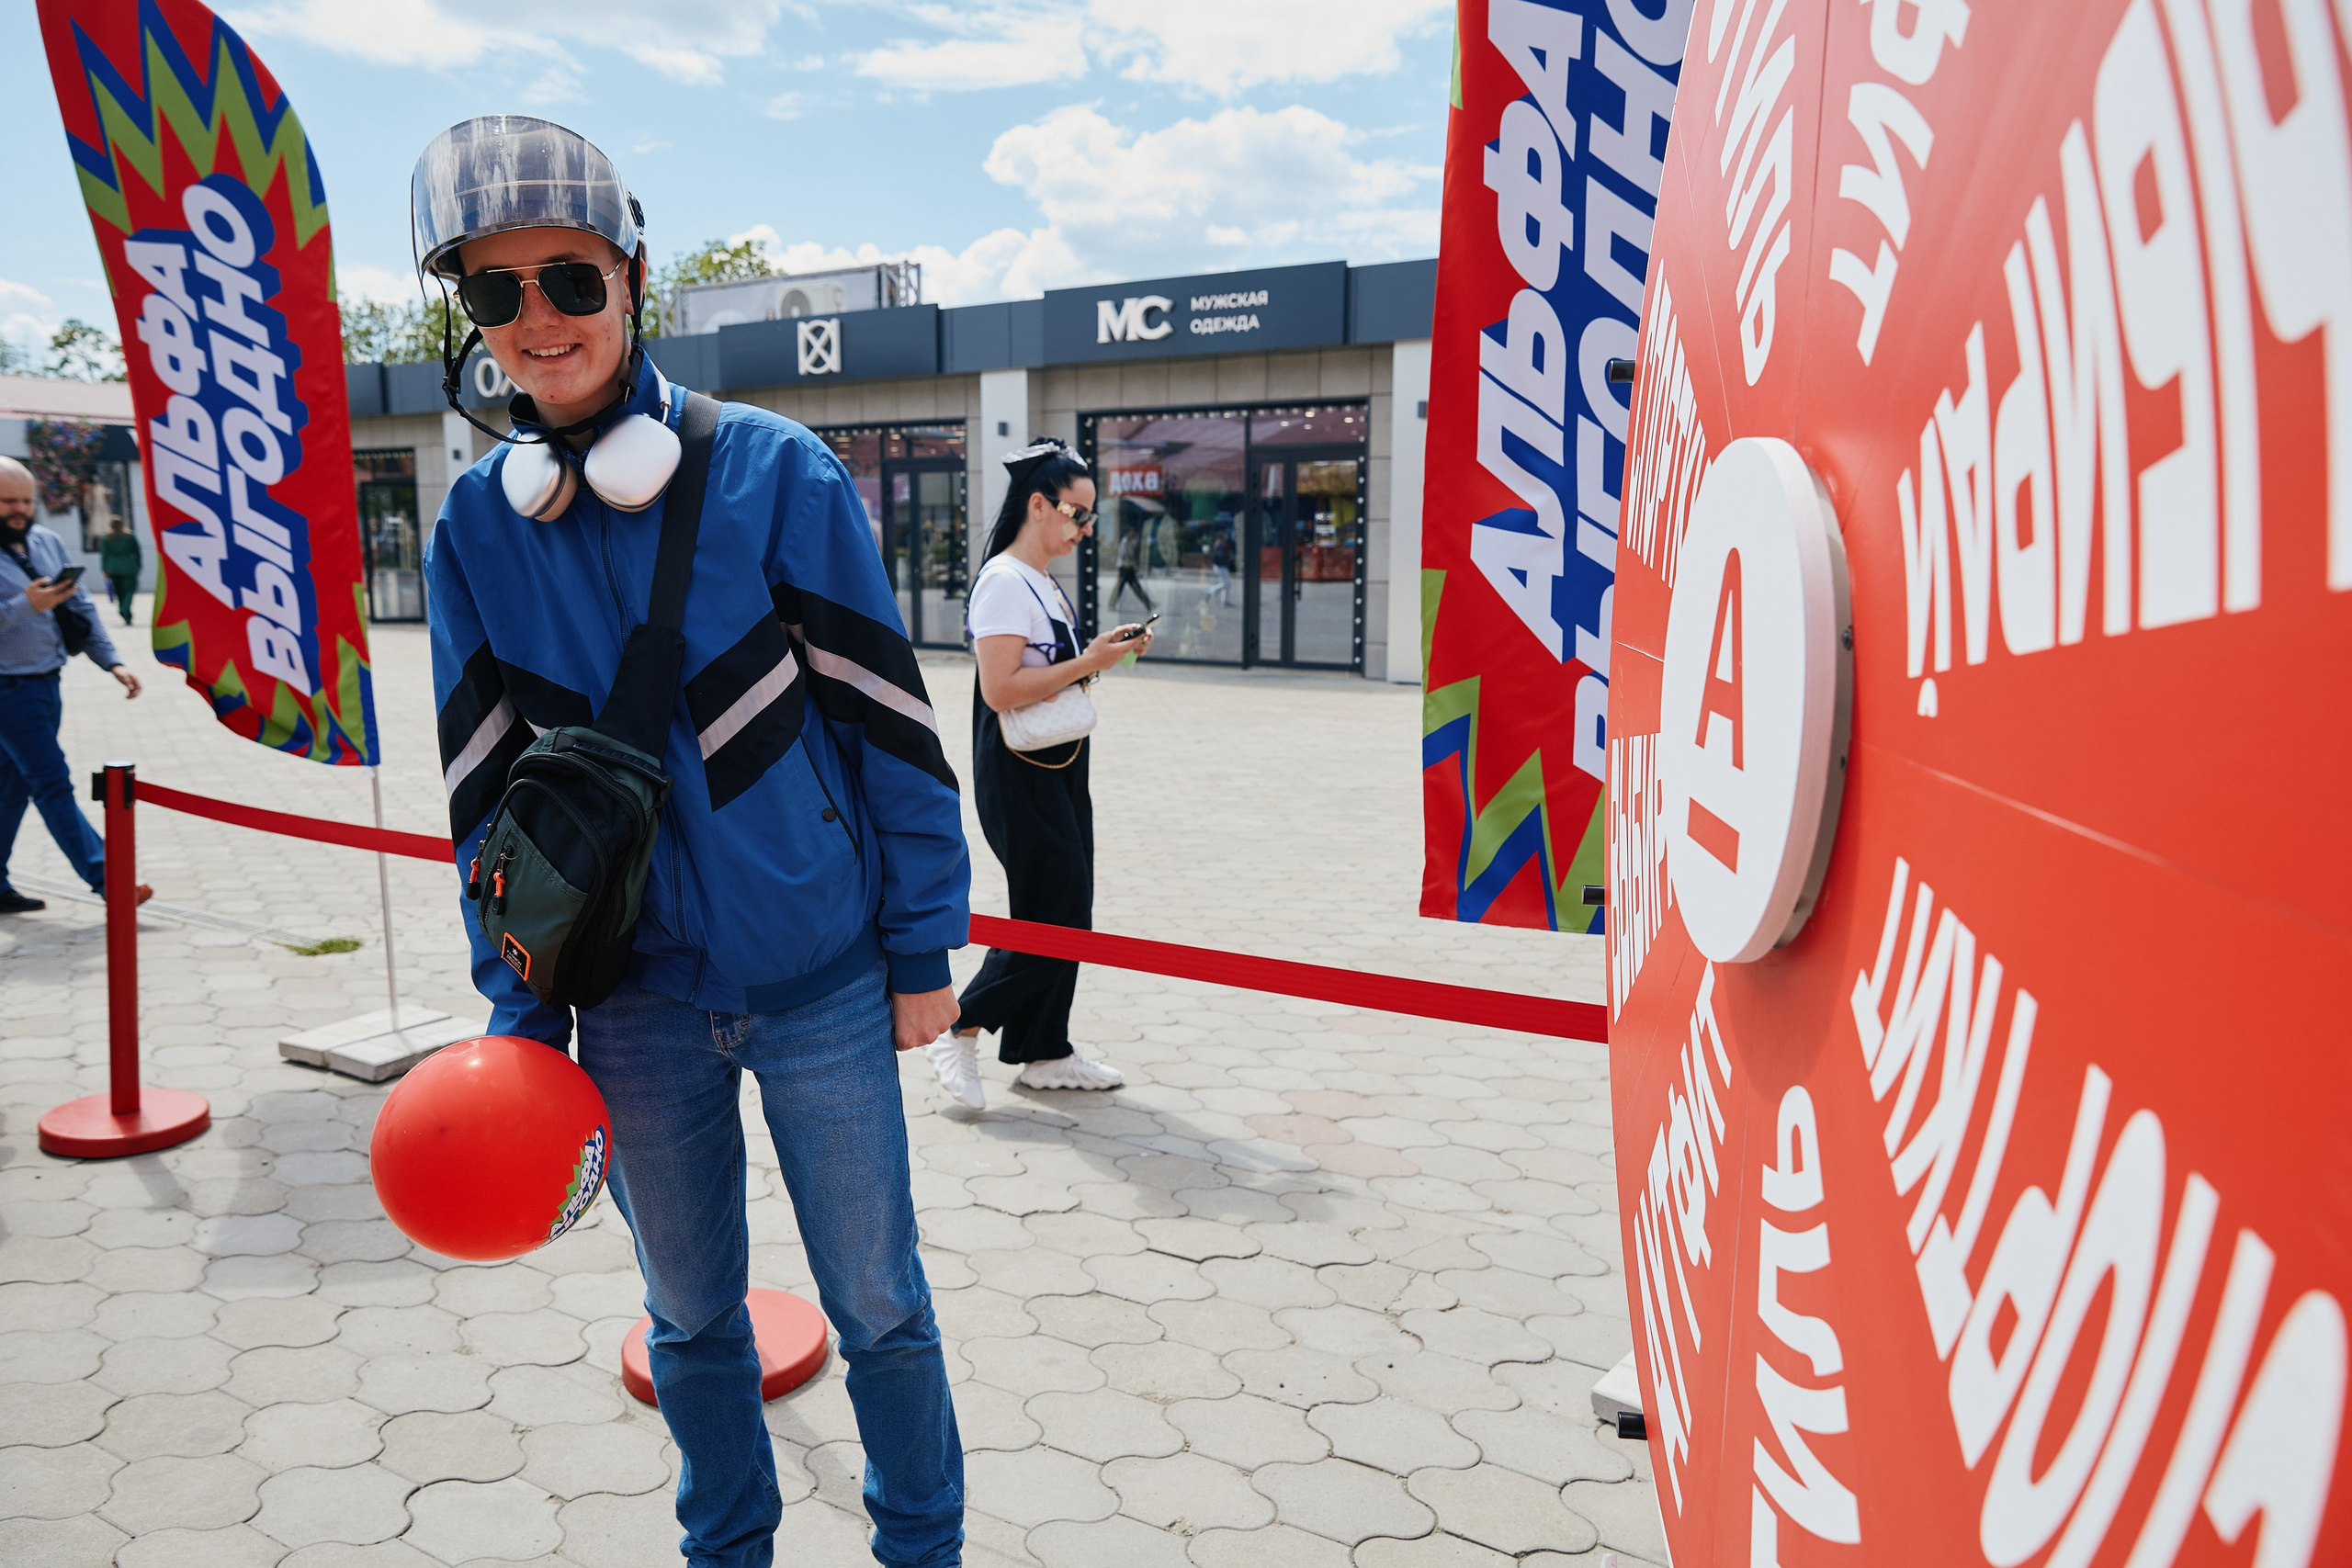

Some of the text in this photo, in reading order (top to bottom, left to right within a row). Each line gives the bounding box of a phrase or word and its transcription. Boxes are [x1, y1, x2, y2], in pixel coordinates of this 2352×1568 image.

[1190, 314, 1261, 335] ОДЕЖДА
[1191, 290, 1269, 312] МУЖСКАЯ
[1470, 0, 1583, 664] АЛЬФА
[123, 240, 235, 610] АЛЬФА
[183, 185, 311, 696] ВЫГОДНО
[548, 1145, 595, 1239] АЛЬФА
